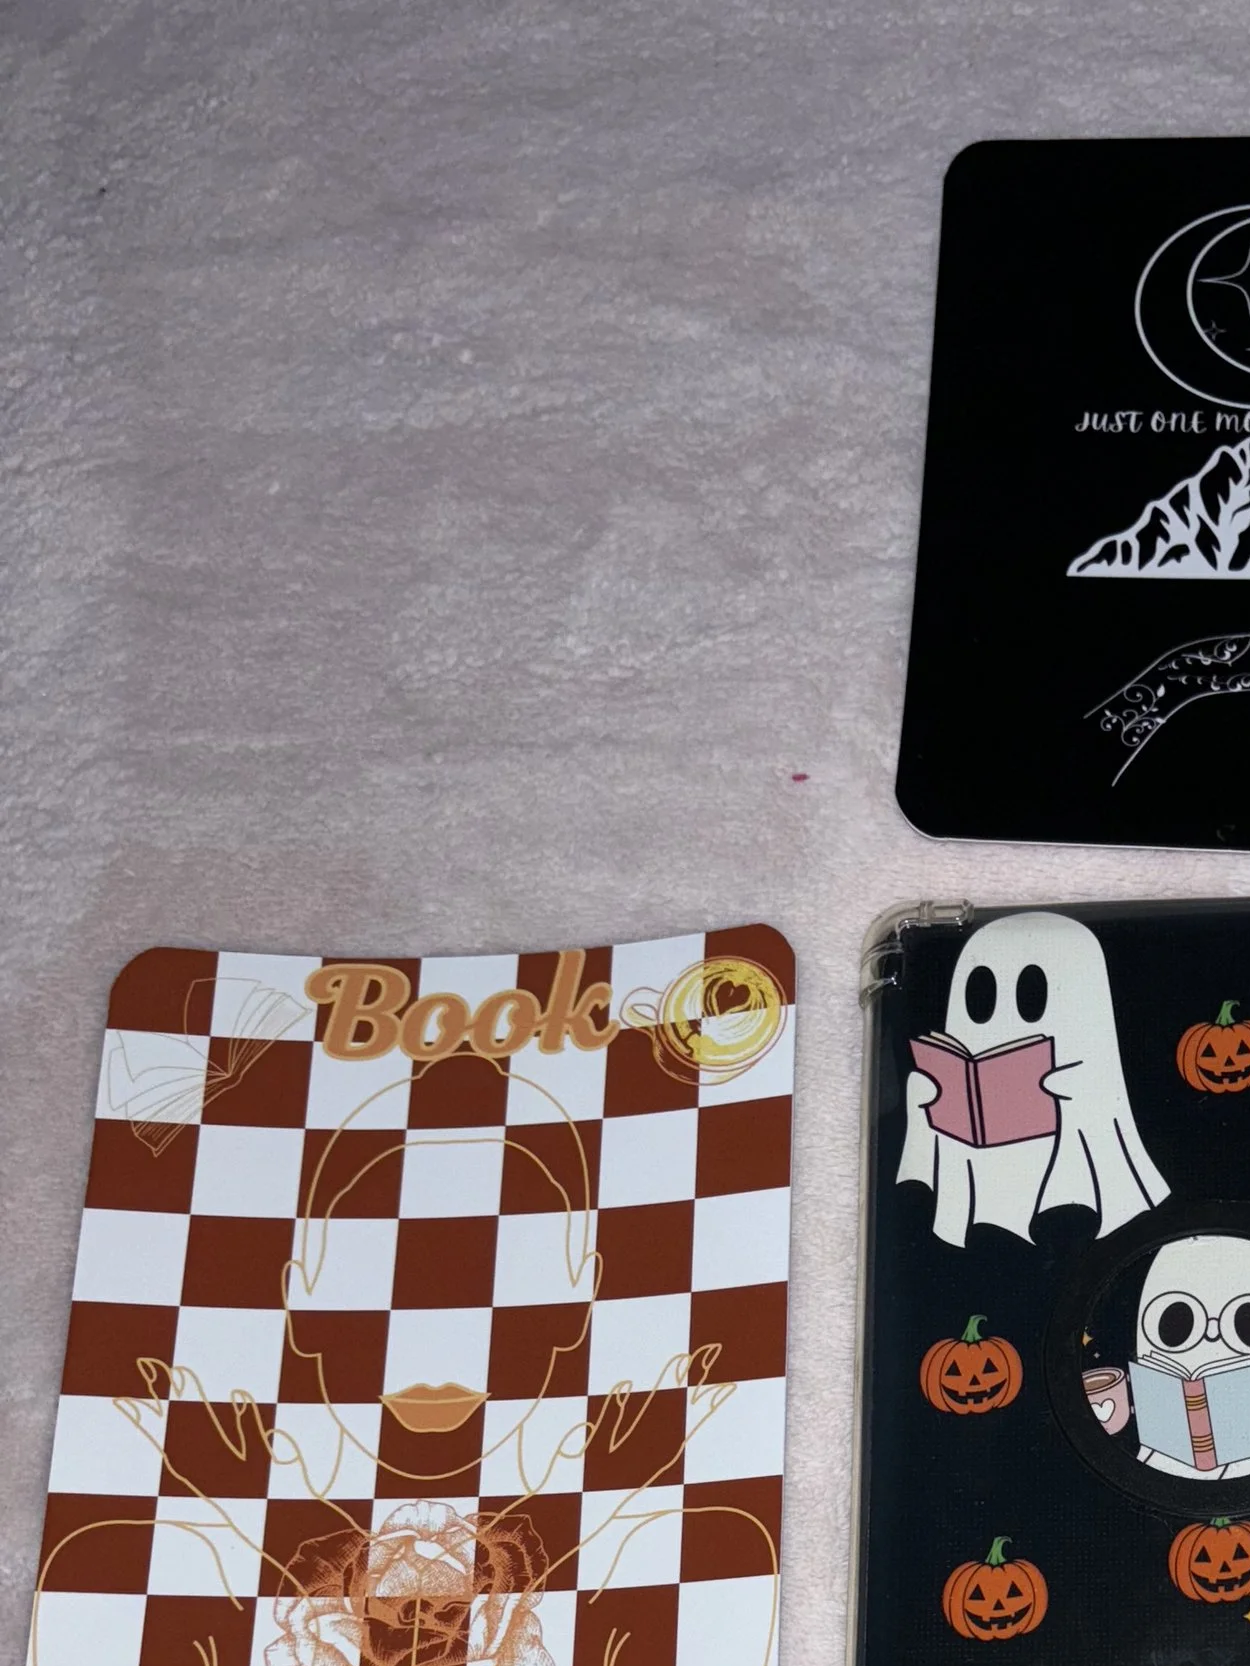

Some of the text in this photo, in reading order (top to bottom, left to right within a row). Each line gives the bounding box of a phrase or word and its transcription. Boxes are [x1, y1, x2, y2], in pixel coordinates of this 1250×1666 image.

[1075, 410, 1143, 433] JUST
[1150, 410, 1207, 433] ONE
[305, 949, 620, 1061] Book
